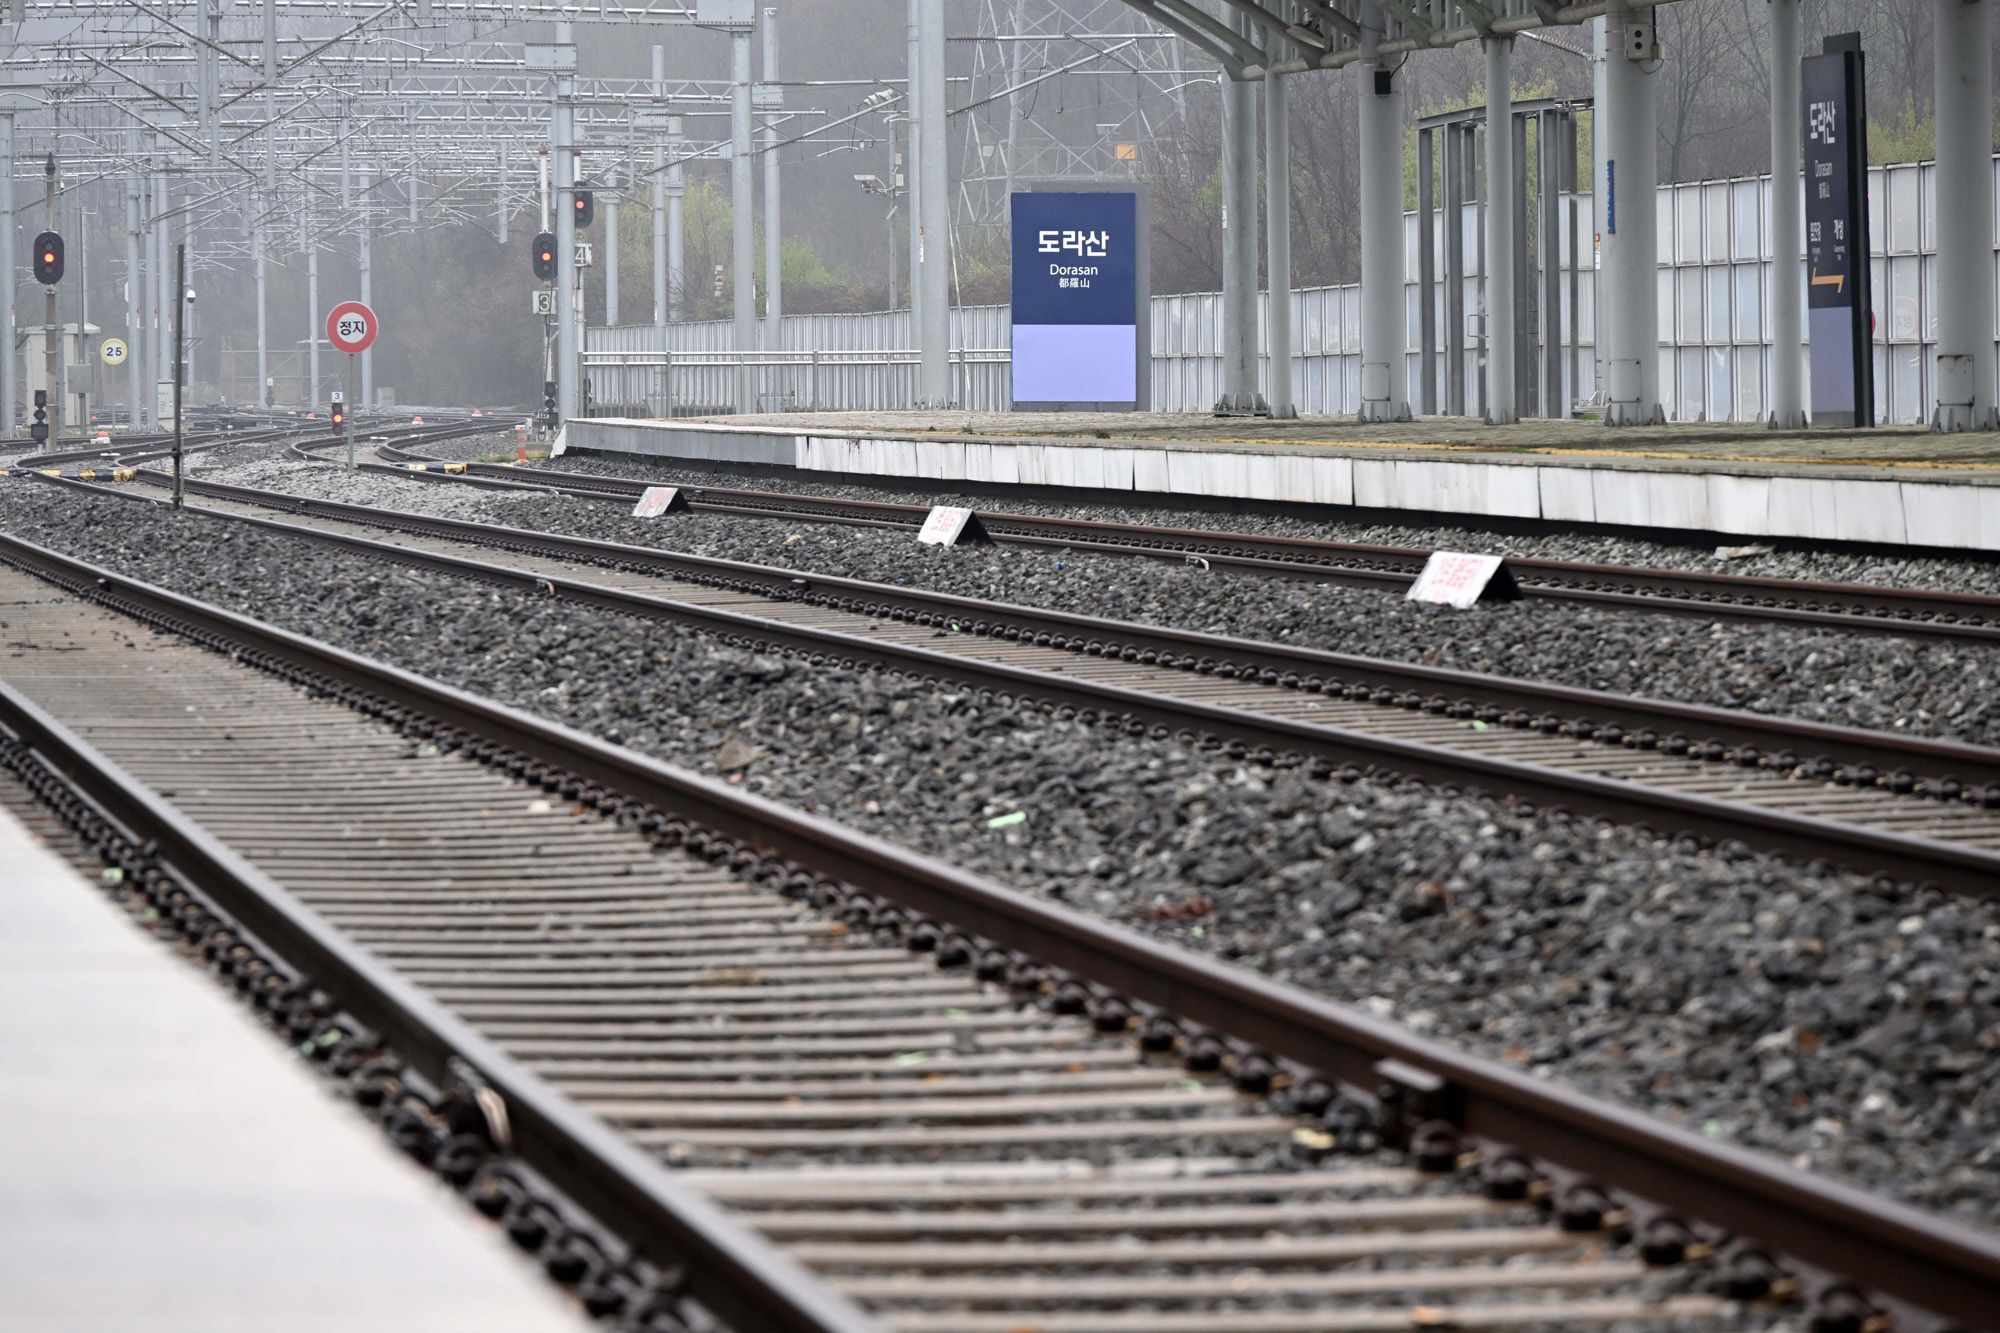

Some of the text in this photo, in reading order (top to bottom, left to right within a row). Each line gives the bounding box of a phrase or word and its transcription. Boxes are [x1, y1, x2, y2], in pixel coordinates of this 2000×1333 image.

[1810, 101, 1836, 144] 도라산
[1038, 230, 1110, 257] 도라산
[575, 247, 585, 264] 4
[1049, 263, 1099, 275] Dorasan
[1058, 277, 1090, 288] 都羅山
[540, 295, 550, 311] 3
[339, 320, 365, 336] 정지
[106, 347, 122, 356] 25
[334, 392, 340, 400] 3
